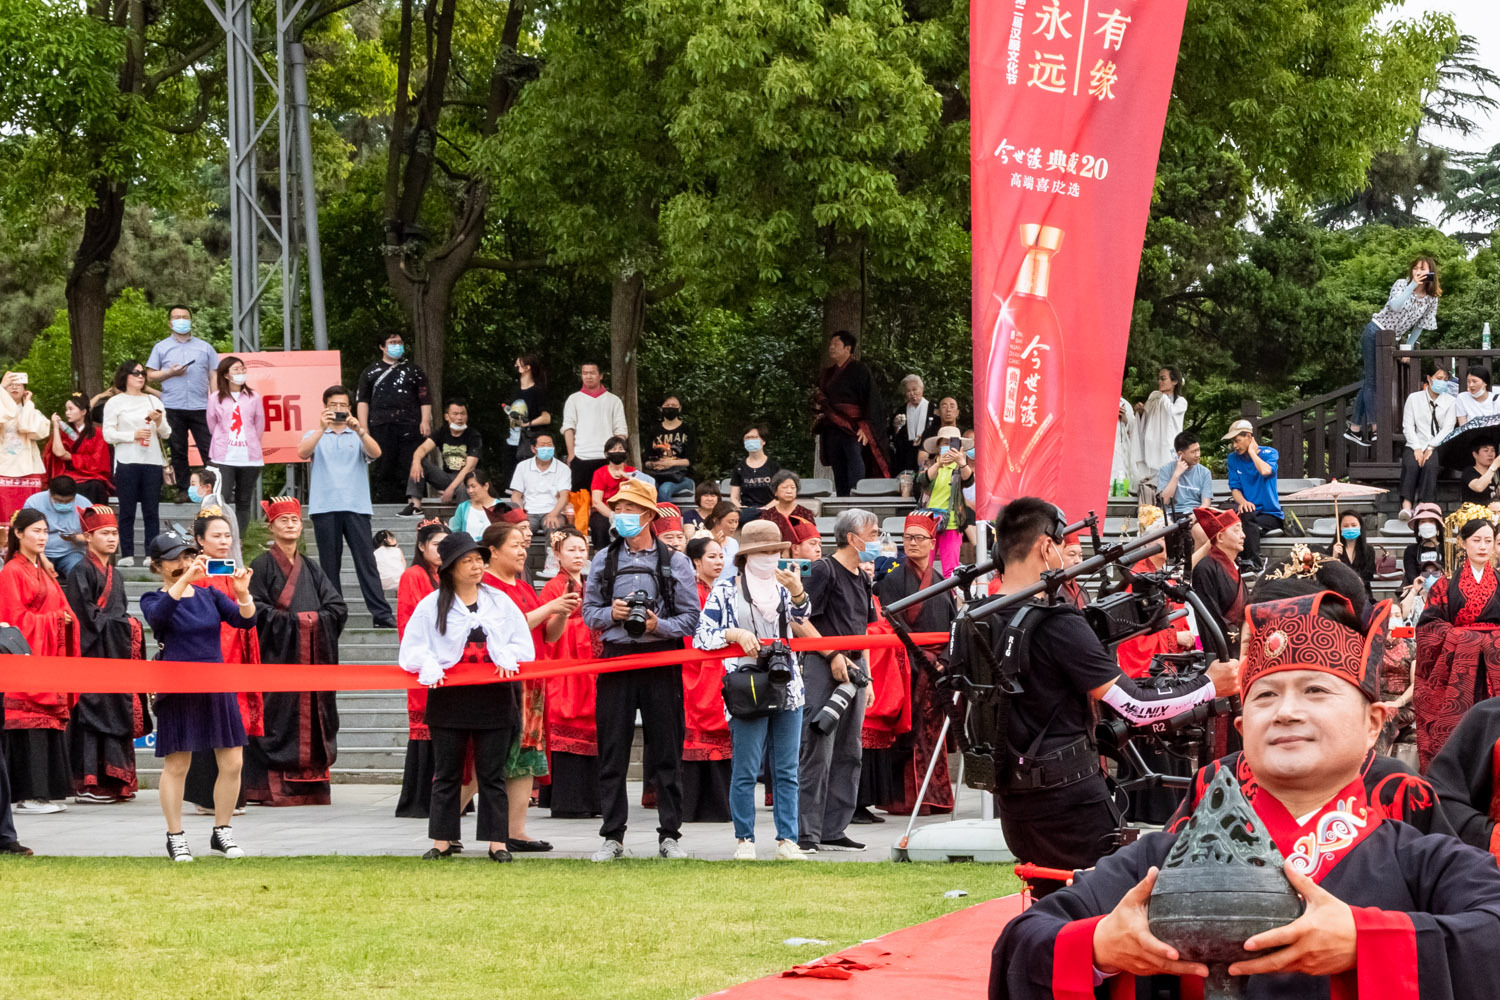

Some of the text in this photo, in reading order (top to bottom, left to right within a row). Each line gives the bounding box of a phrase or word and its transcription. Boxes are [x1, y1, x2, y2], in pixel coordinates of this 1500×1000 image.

[1027, 0, 1072, 93] 永远
[1088, 8, 1131, 100] 有缘
[1005, 635, 1014, 657] RIG
[1151, 722, 1167, 733] R2
